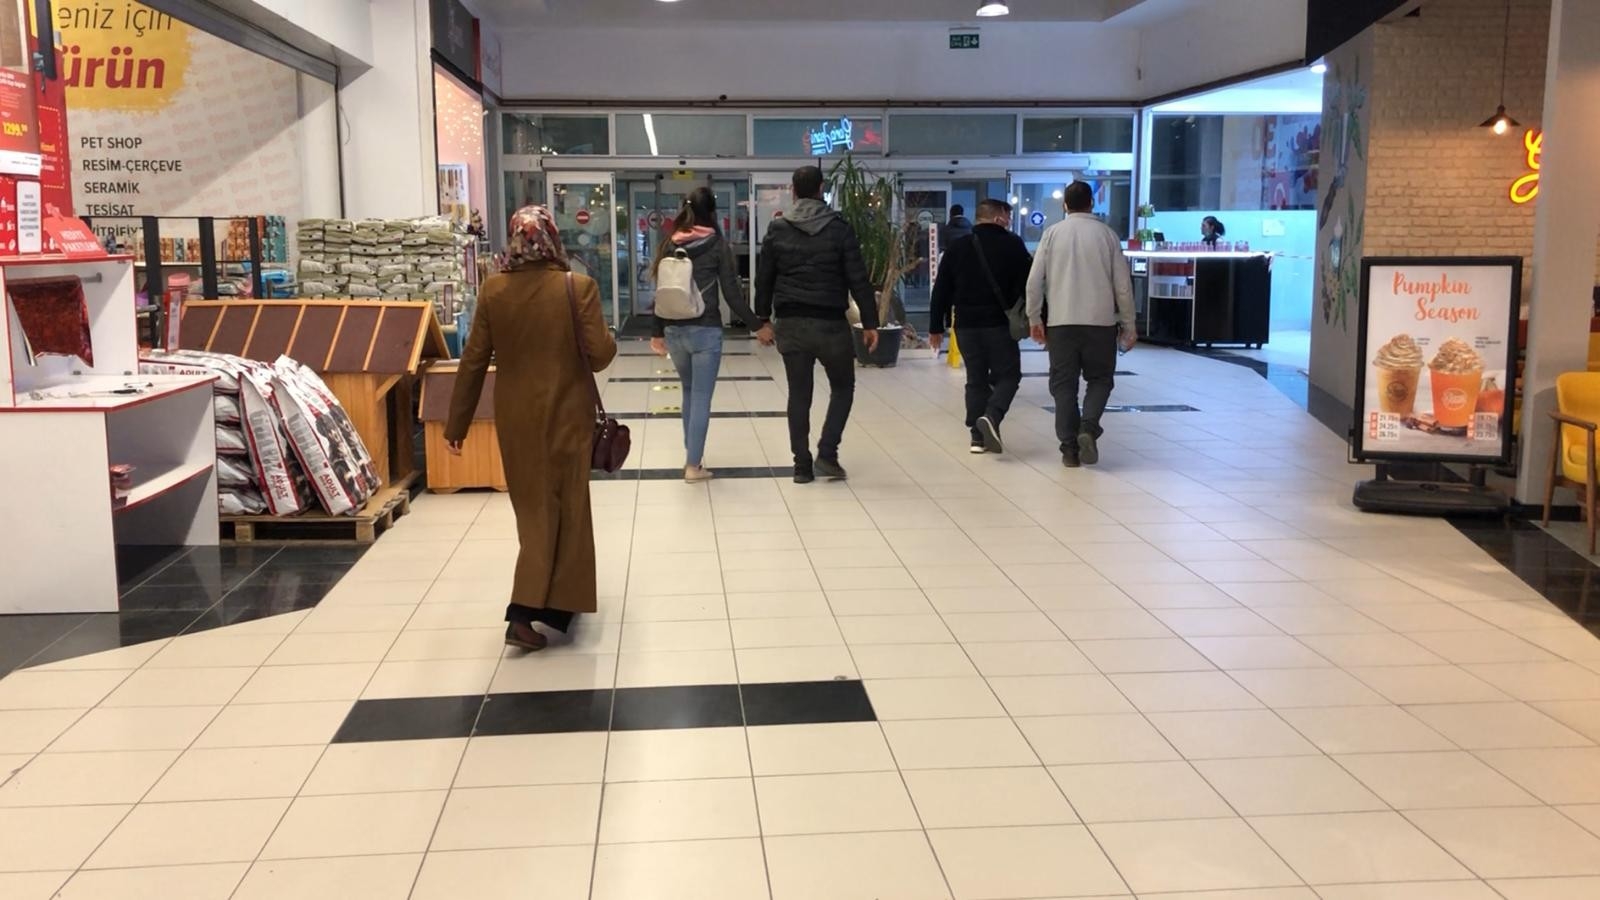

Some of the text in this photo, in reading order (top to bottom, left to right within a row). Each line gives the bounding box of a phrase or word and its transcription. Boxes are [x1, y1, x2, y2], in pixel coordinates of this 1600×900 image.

[81, 137, 143, 149] PET SHOP
[82, 157, 182, 174] RESİM-ÇERÇEVE
[84, 180, 141, 194] SERAMİK
[86, 203, 135, 216] TESİSAT
[1393, 271, 1472, 303] Pumpkin
[1415, 297, 1481, 323] Season
[322, 473, 340, 497] ADULT
